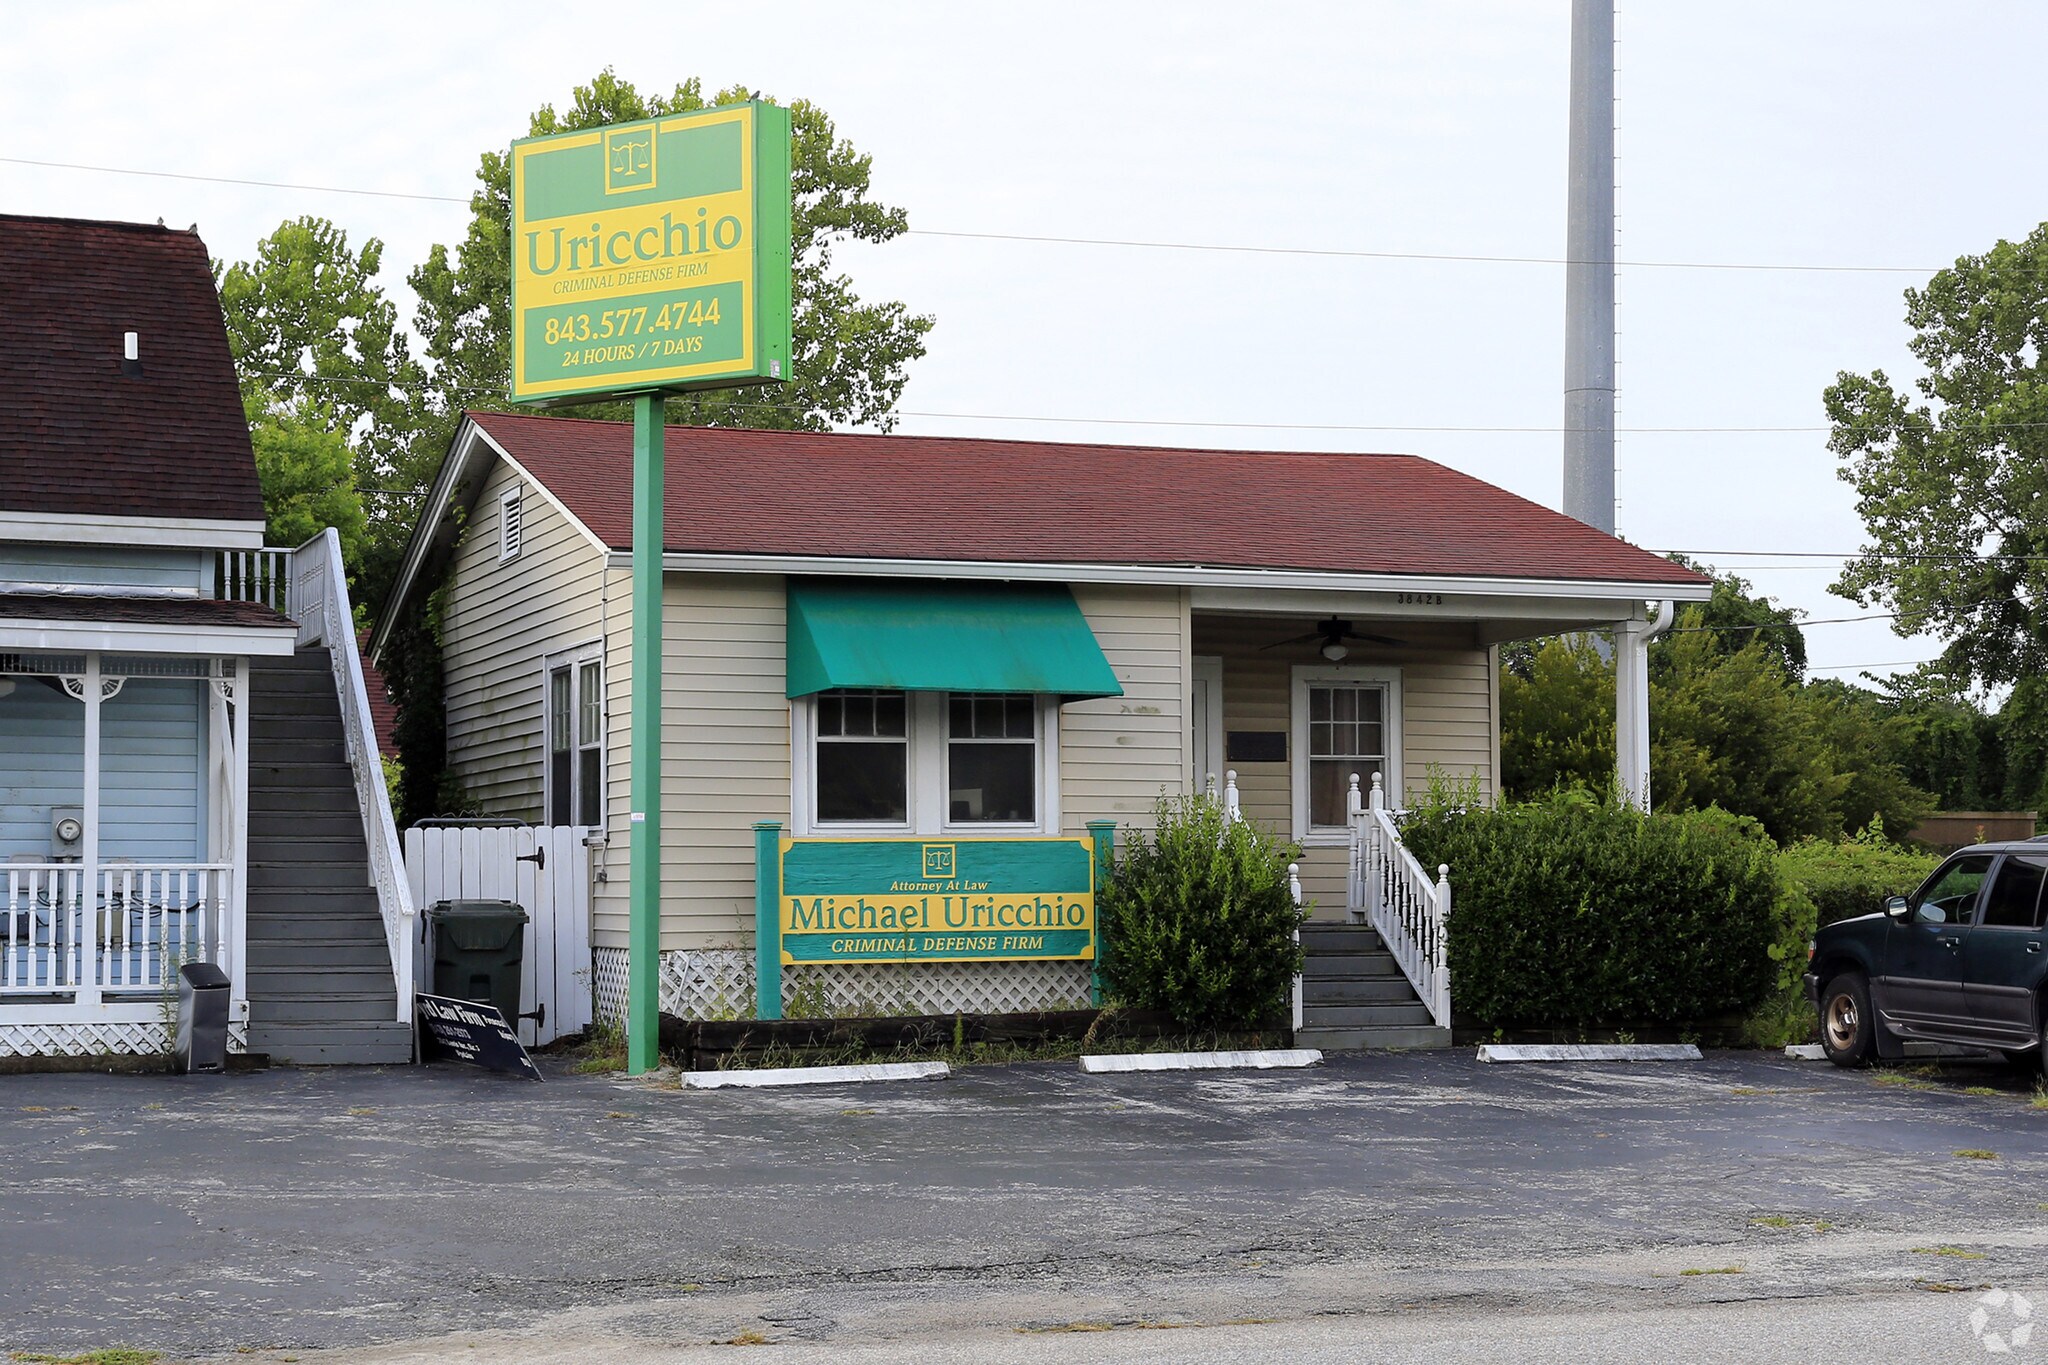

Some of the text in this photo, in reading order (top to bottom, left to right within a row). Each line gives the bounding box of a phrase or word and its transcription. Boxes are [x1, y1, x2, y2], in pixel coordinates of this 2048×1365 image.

[524, 207, 742, 276] Uricchio
[553, 262, 709, 295] CRIMINAL DEFENSE FIRM
[544, 297, 721, 345] 843.577.4744
[561, 350, 580, 368] 24
[583, 344, 635, 365] HOURS
[651, 341, 661, 357] 7
[663, 336, 703, 356] DAYS
[890, 880, 988, 894] Attorney At Law
[789, 895, 1085, 931] Michael Uricchio
[831, 936, 1044, 953] CRIMINAL DEFENSE FIRM
[430, 1000, 459, 1021] Law
[453, 1004, 486, 1027] Firm
